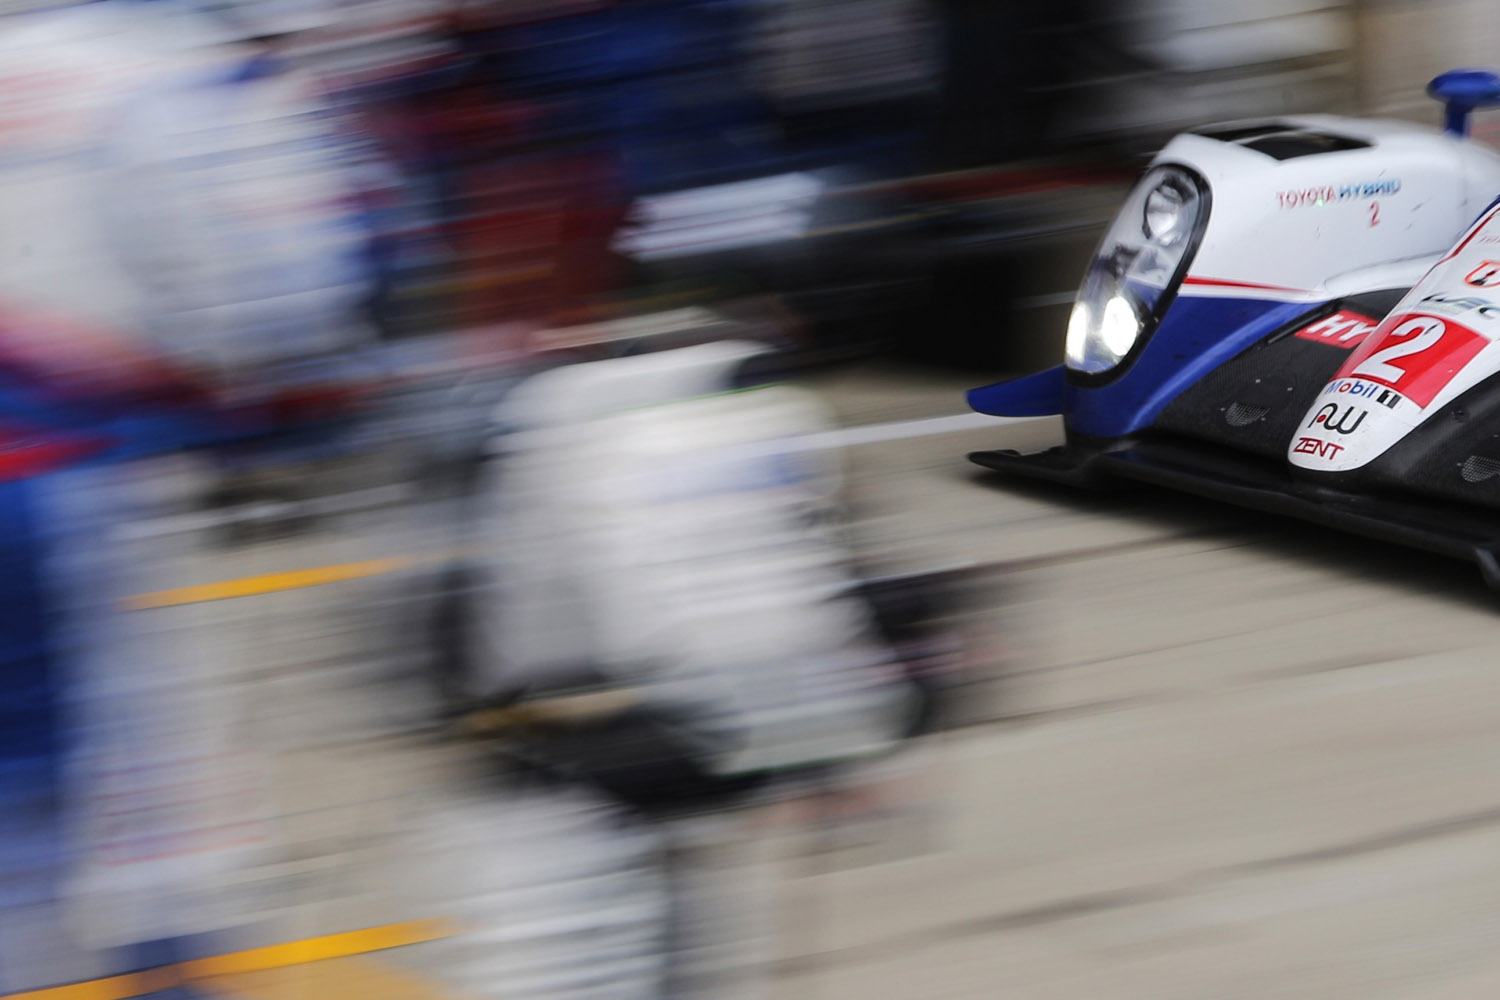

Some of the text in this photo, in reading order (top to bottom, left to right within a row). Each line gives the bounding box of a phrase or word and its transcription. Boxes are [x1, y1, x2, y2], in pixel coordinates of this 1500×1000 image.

[1277, 179, 1402, 208] TOYOTA HYBRID
[1368, 201, 1381, 228] 2
[1351, 315, 1446, 384] 2
[1325, 380, 1380, 399] Mobil
[1293, 437, 1344, 460] ZENT
